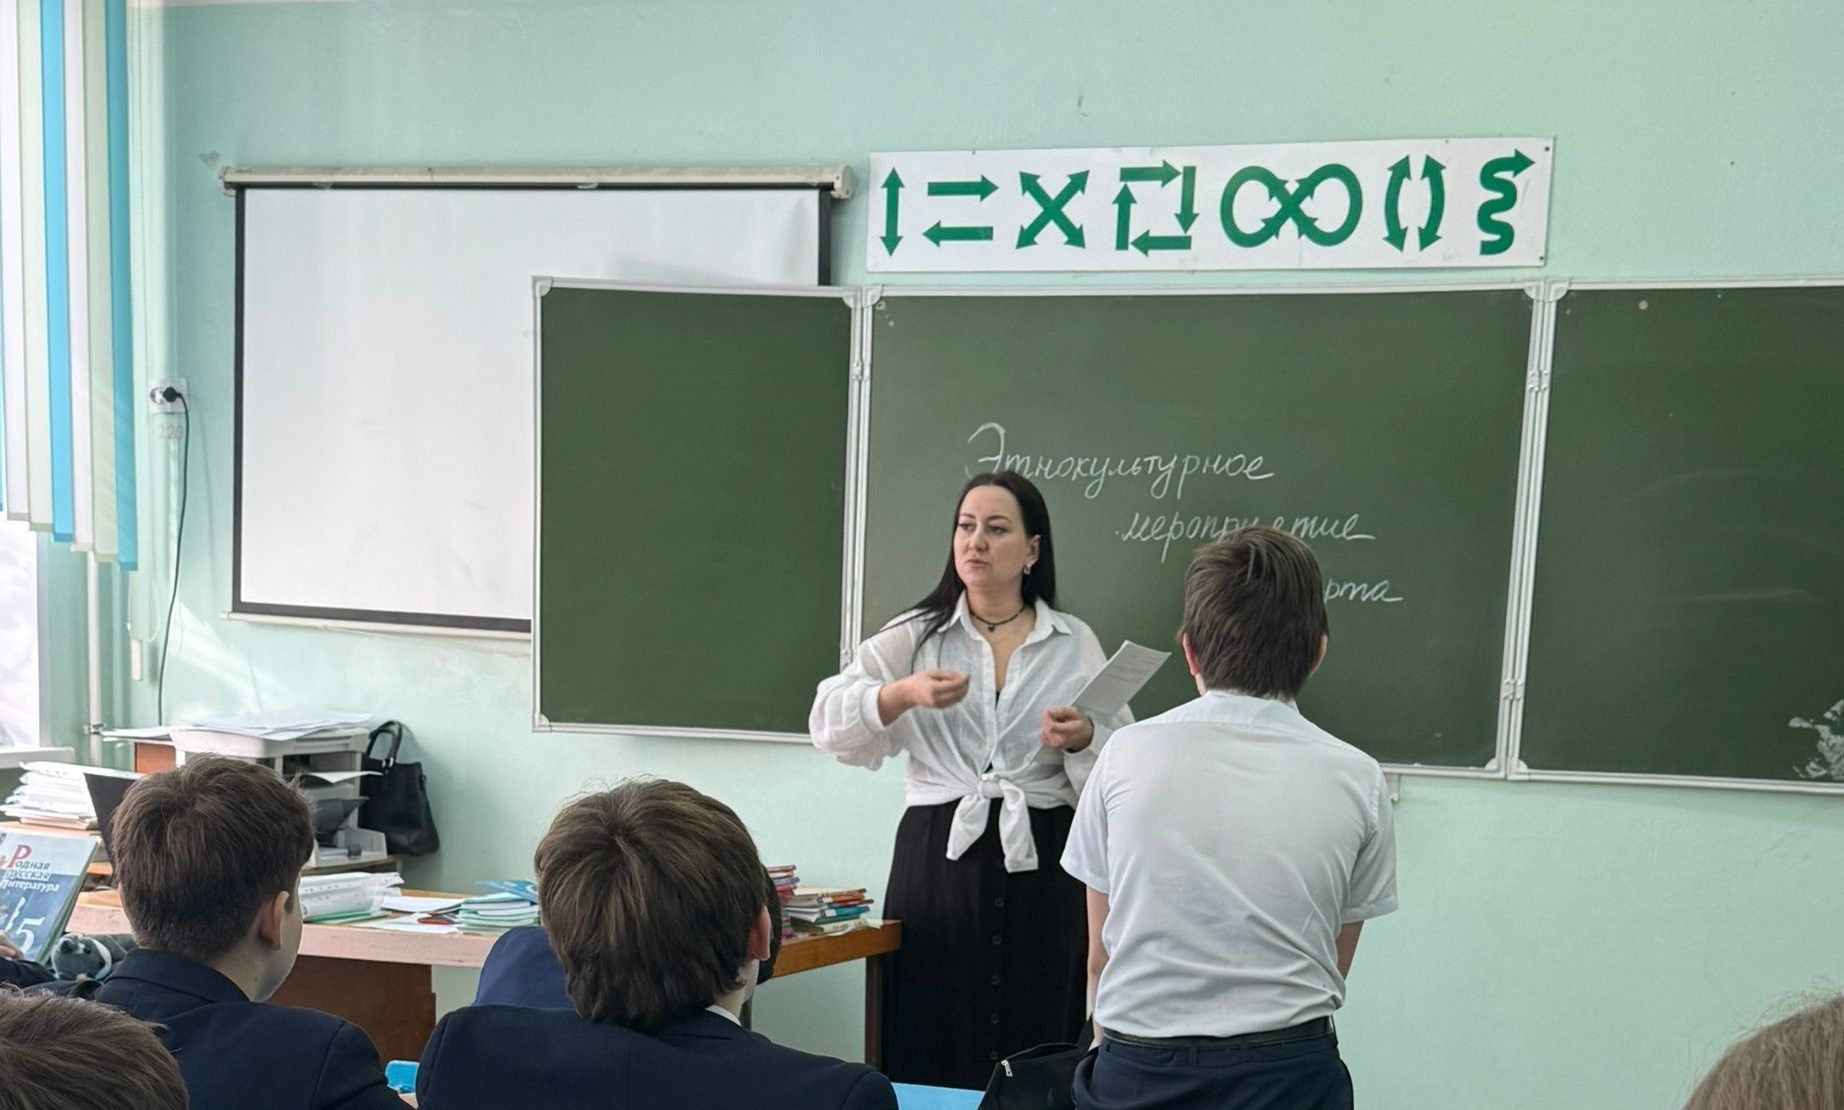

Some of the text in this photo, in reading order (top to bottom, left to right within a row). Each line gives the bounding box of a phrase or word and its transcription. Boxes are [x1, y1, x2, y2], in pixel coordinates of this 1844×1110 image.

[965, 422, 1275, 500] Этнокультурное
[7, 844, 51, 870] Родная
[16, 917, 45, 953] 5
